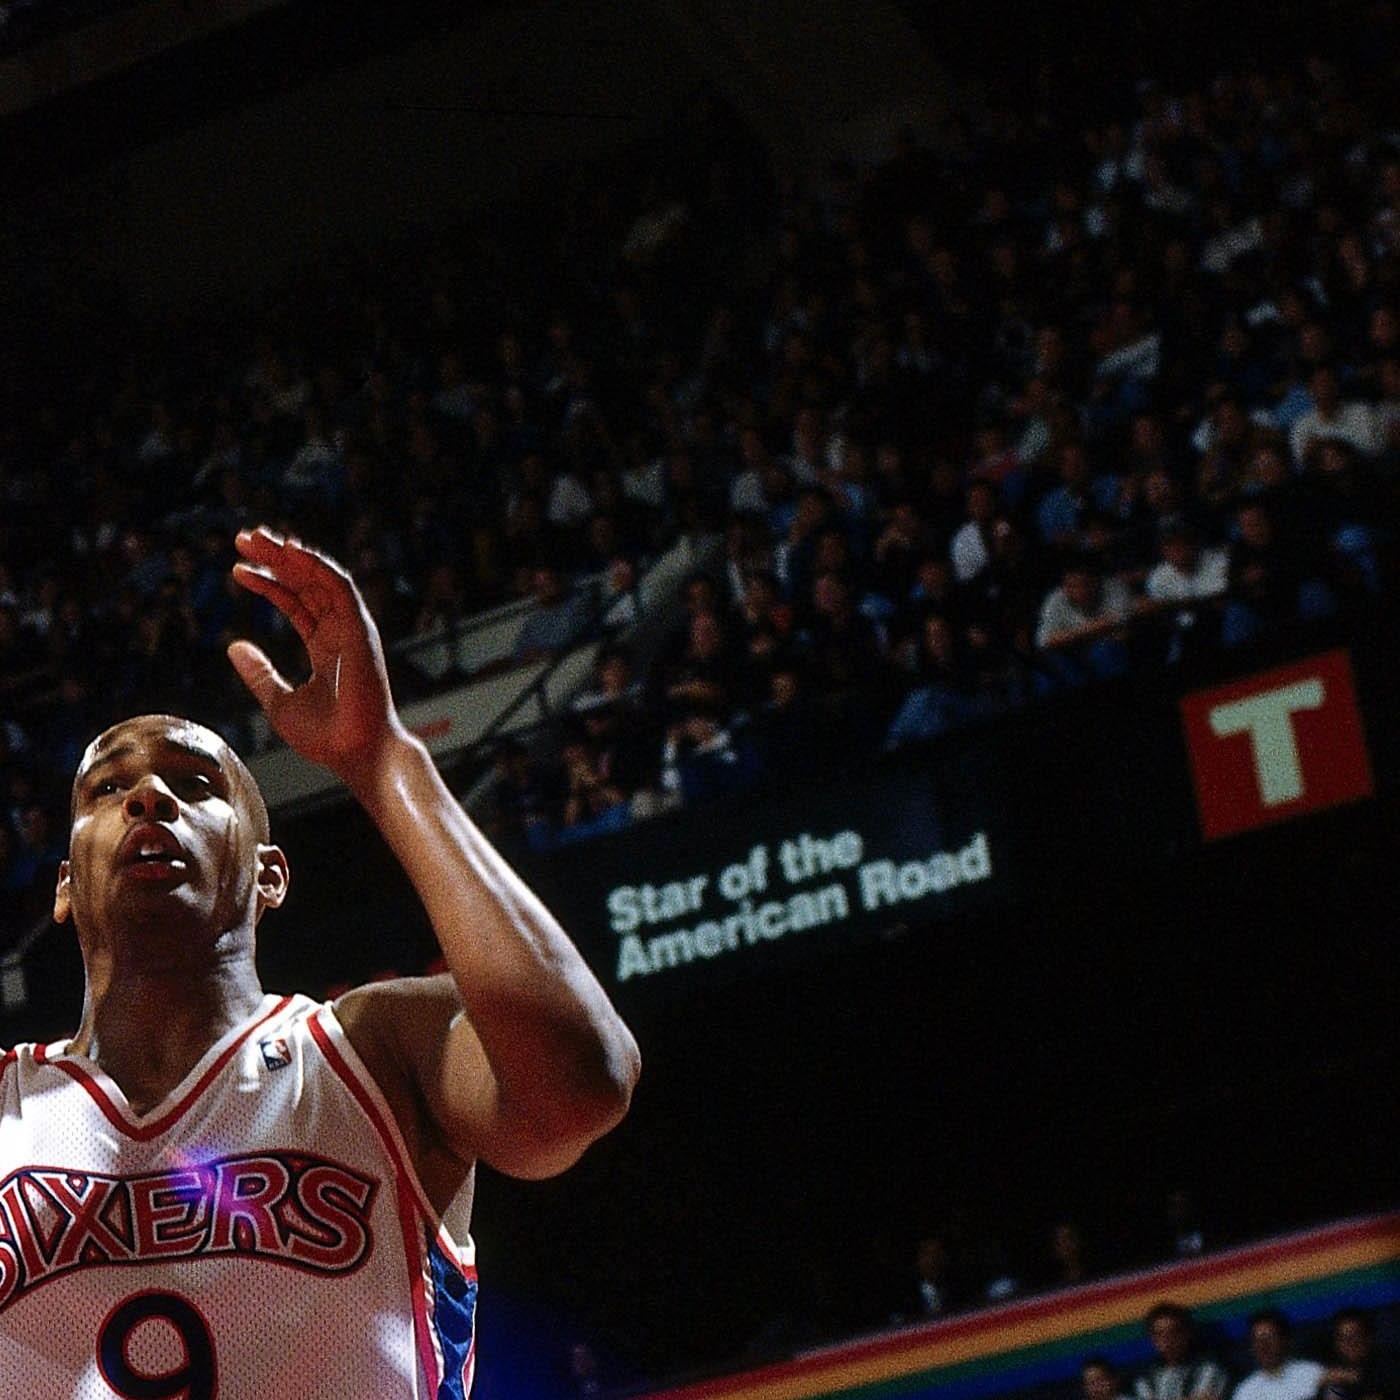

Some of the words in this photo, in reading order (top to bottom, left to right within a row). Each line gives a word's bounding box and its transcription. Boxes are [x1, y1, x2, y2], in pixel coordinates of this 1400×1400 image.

[1208, 678, 1327, 806] T
[607, 873, 710, 935] Star
[718, 843, 770, 900] of
[779, 829, 864, 883] the
[616, 883, 849, 982] American
[858, 831, 993, 912] Road
